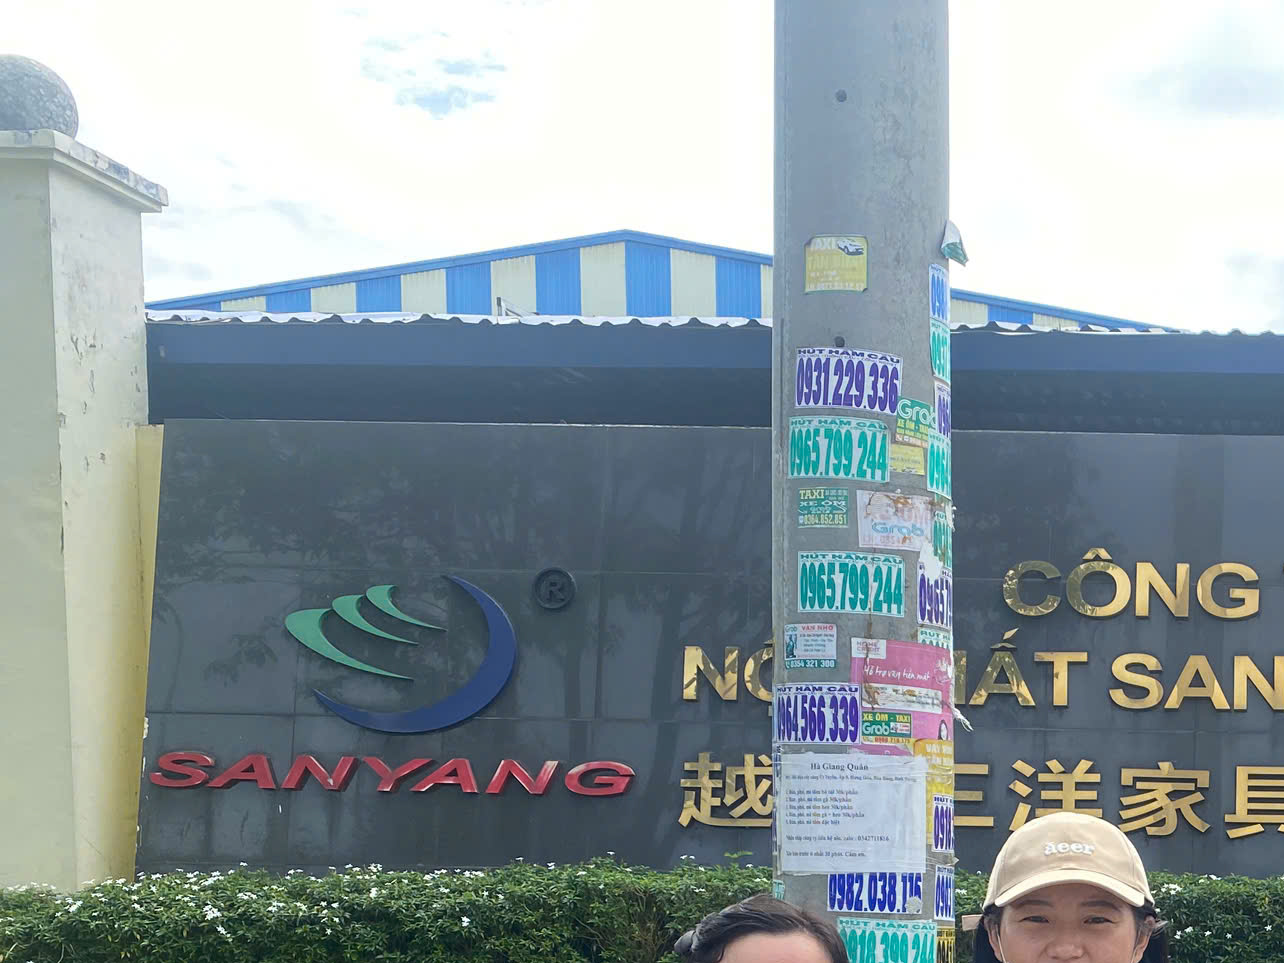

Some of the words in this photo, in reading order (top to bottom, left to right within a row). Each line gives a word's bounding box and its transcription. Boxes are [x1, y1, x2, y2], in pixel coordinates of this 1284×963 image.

[796, 357, 899, 413] 0931.229.336
[790, 428, 887, 480] 0965.799.244
[799, 489, 825, 500] TAXI
[800, 562, 903, 615] 0965.799.244
[1003, 547, 1261, 620] CÔNG
[953, 627, 1089, 707] ẤT
[778, 694, 859, 743] 0964.566.339
[862, 721, 890, 735] Grab
[863, 712, 873, 721] XE
[896, 714, 911, 723] TAXI
[149, 750, 637, 798] SANYANG
[810, 762, 821, 770] Hà
[822, 762, 845, 771] Giang
